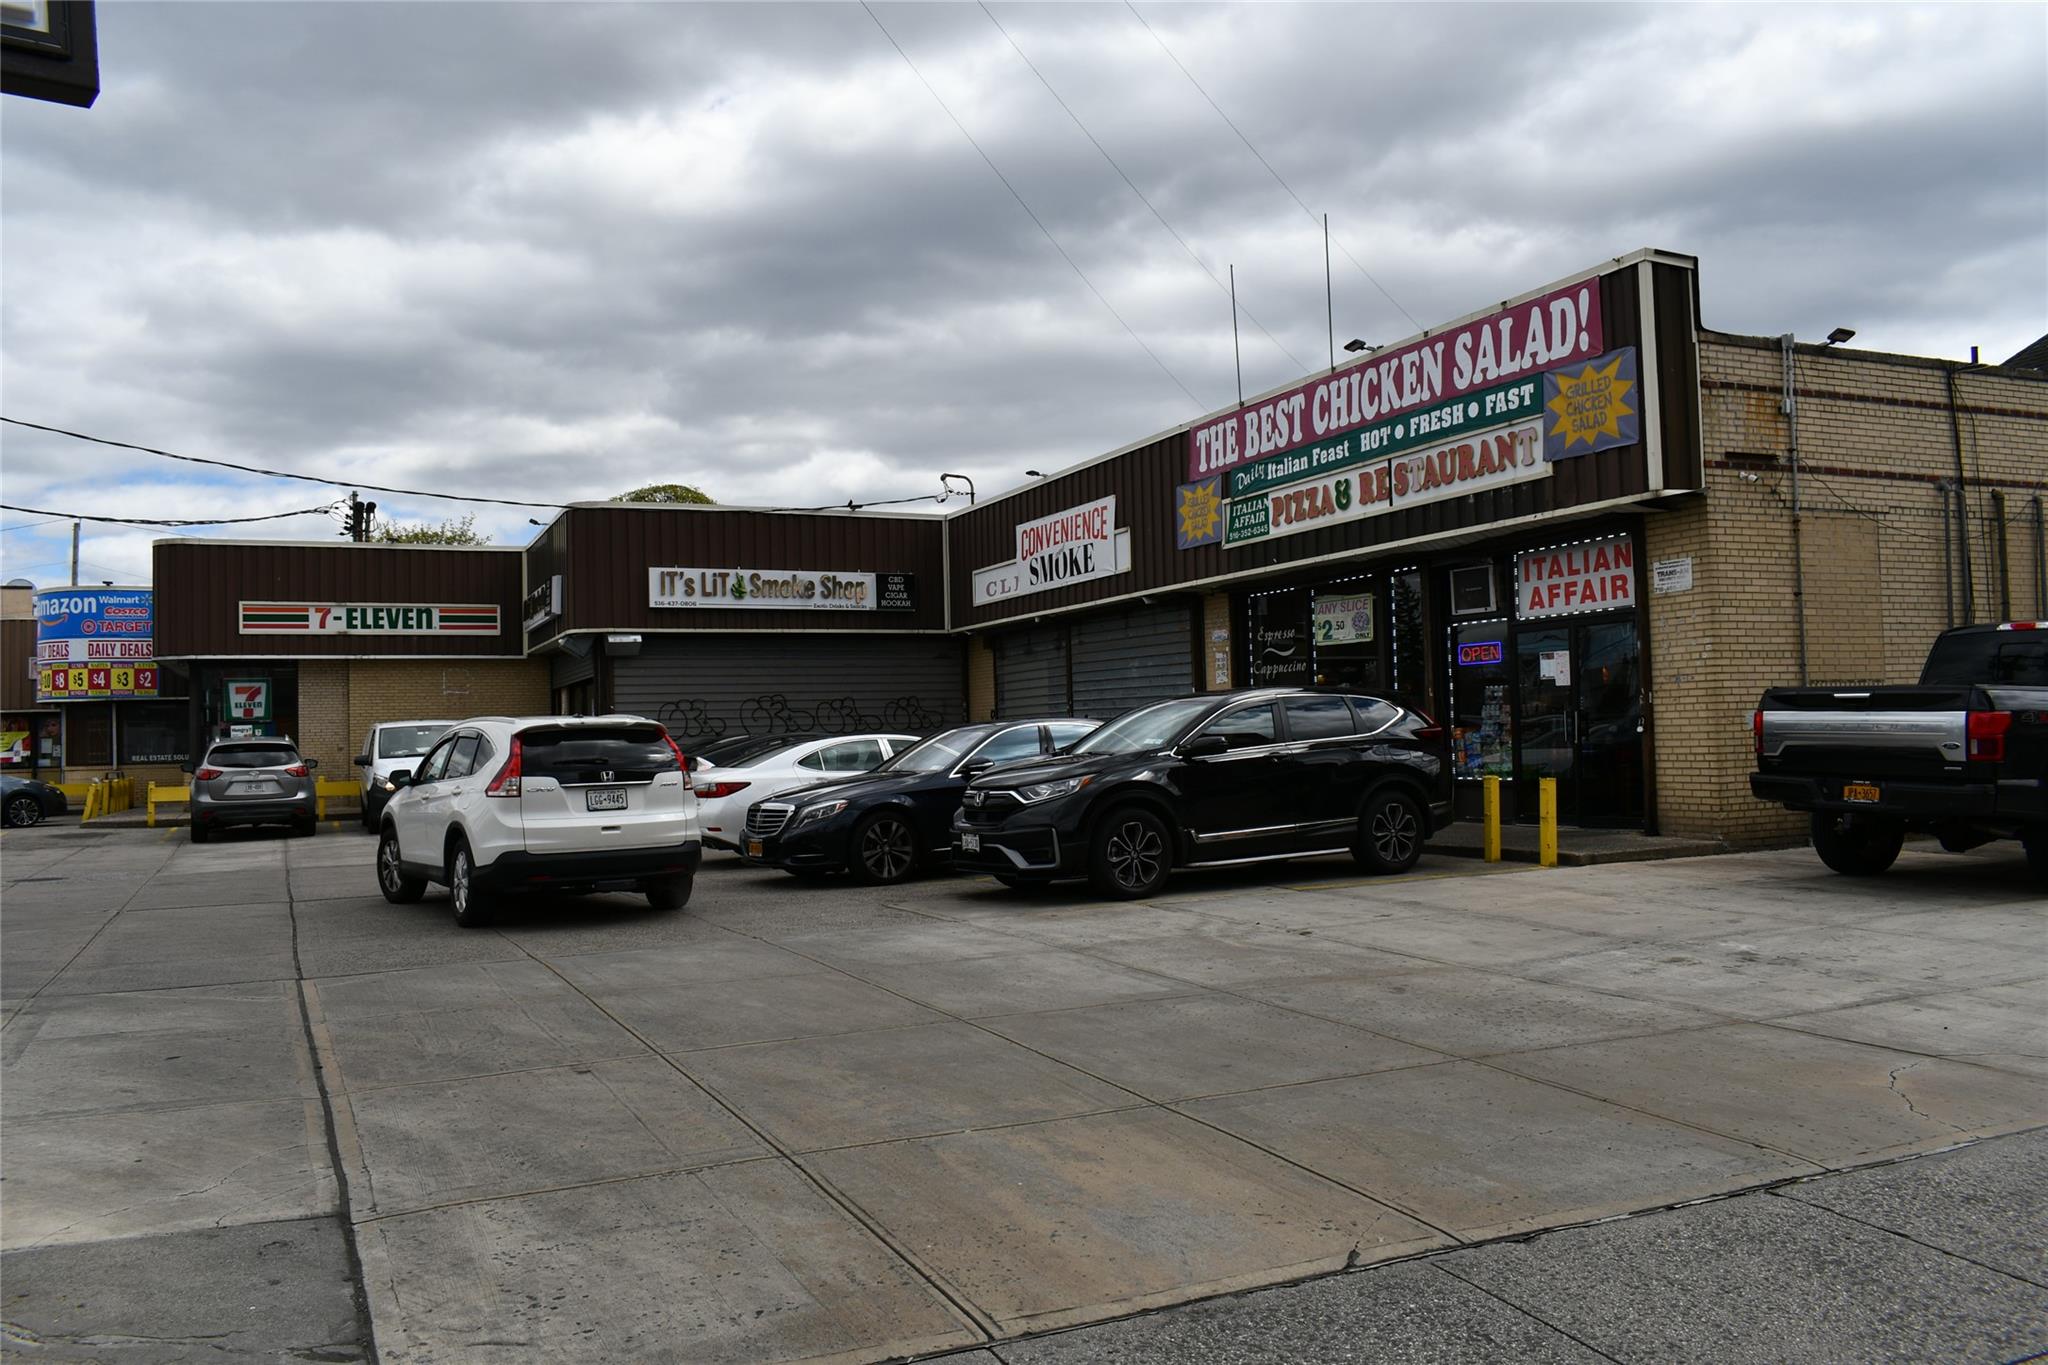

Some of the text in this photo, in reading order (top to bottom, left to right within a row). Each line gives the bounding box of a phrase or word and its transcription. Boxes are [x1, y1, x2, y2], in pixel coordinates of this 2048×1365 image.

[1196, 287, 1590, 473] THE BEST CHICKEN SALAD!
[1565, 375, 1612, 400] GRILLED
[1566, 391, 1613, 417] CHICKEN
[1267, 455, 1308, 480] Italian
[1312, 440, 1350, 467] Feast
[1410, 403, 1464, 438] FRESH
[1485, 383, 1534, 416] FAST
[1571, 411, 1607, 433] SALAD
[1271, 484, 1336, 527] PIZZA
[1358, 426, 1538, 506] RESTAURANT
[1232, 497, 1270, 517] ITALIAN
[1233, 510, 1266, 530] AFFAIR
[1021, 505, 1108, 561] CONVENIENCE
[1029, 543, 1095, 586] SMOKE
[1523, 542, 1633, 583] ITALIAN
[749, 572, 816, 599] Smoke
[819, 574, 868, 605] Shop
[1528, 573, 1630, 611] AFFAIR
[98, 595, 140, 604] Walmart
[1317, 599, 1369, 615] ANY SLICE
[98, 620, 152, 633] TARGET
[1257, 626, 1296, 646] Espresso
[48, 644, 69, 658] DEALS
[88, 643, 152, 658] DAILY DEALS
[1461, 645, 1500, 663] OPEN
[55, 672, 65, 688] $8
[73, 672, 84, 687] $5
[92, 671, 106, 687] $4
[116, 671, 129, 687] $3
[139, 671, 152, 687] $2
[1253, 660, 1307, 680] Cappuccino
